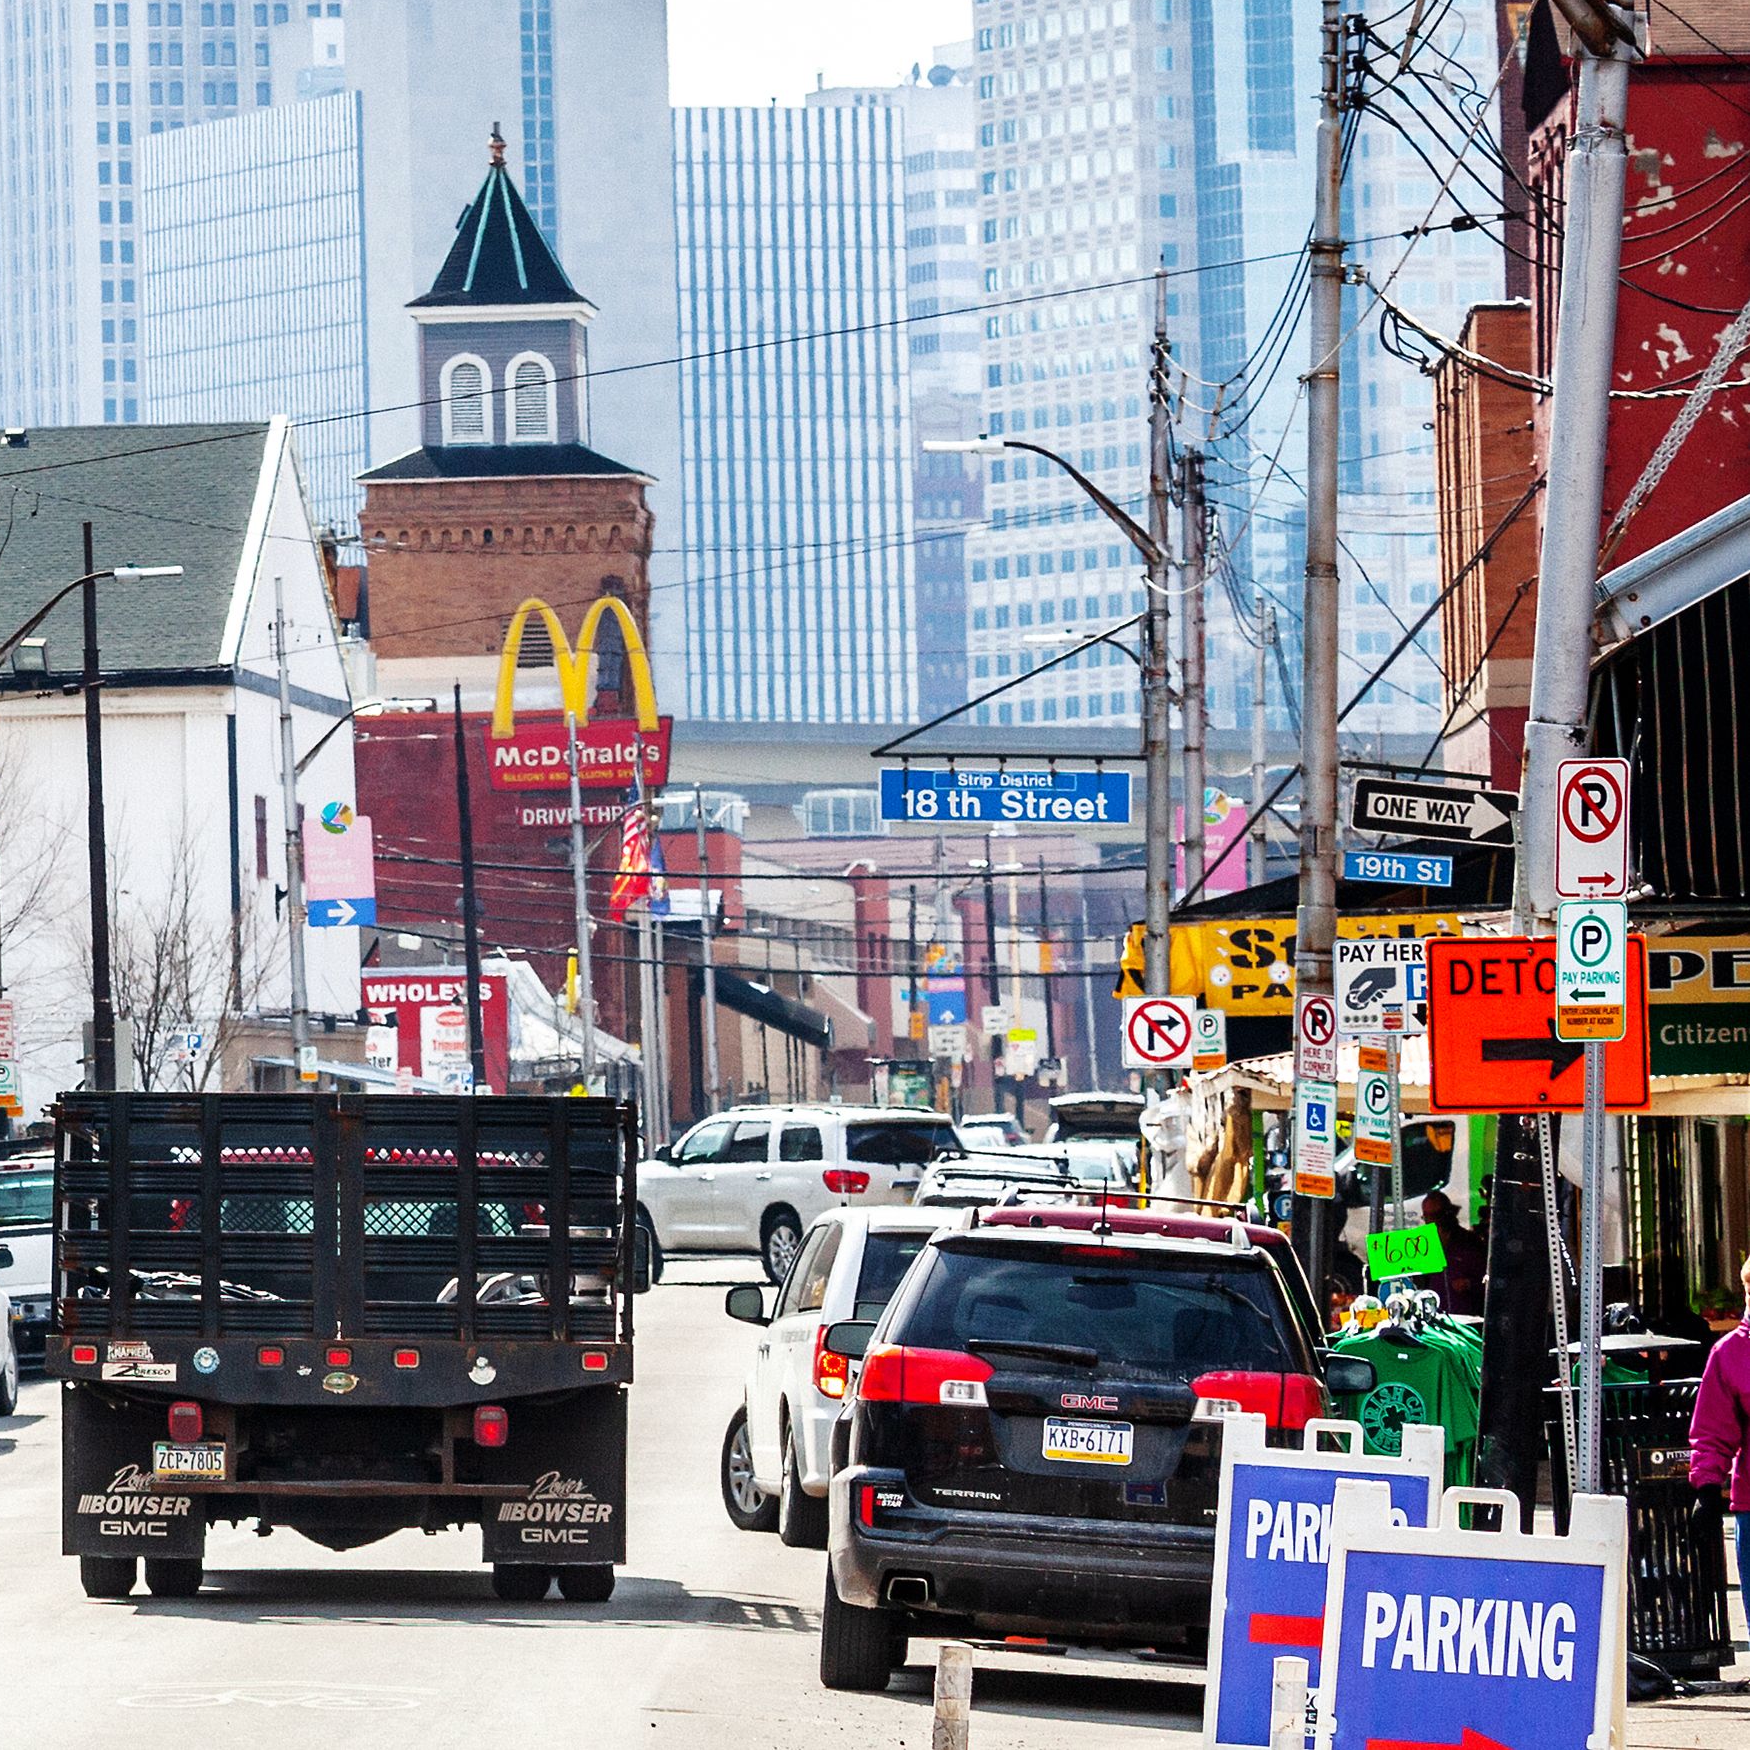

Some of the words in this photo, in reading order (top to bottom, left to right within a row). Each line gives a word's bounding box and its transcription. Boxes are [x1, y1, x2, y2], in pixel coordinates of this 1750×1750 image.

[957, 773, 993, 788] Strip
[1000, 774, 1053, 787] District
[901, 789, 938, 818] 18
[947, 790, 981, 818] th
[1001, 790, 1109, 820] Street
[1374, 796, 1418, 820] ONE
[1426, 801, 1472, 826] WAY
[1355, 856, 1407, 880] 19th
[1416, 863, 1444, 883] St
[1339, 944, 1376, 963] PAY
[1383, 943, 1423, 962] HER
[1562, 971, 1578, 984] PAY
[1580, 971, 1620, 985] PARKING
[1303, 1048, 1324, 1059] HERE
[1303, 1061, 1332, 1073] CORNER
[1060, 1393, 1119, 1411] GMC
[528, 1470, 596, 1500] Power
[931, 1487, 1002, 1501] TERRAIN
[88, 1494, 192, 1517] BOWSER
[876, 1492, 904, 1502] NORTH
[511, 1502, 613, 1523] BOWSER
[99, 1520, 168, 1537] GMC
[521, 1527, 589, 1544] GMC
[1361, 1591, 1577, 1683] PARKING
